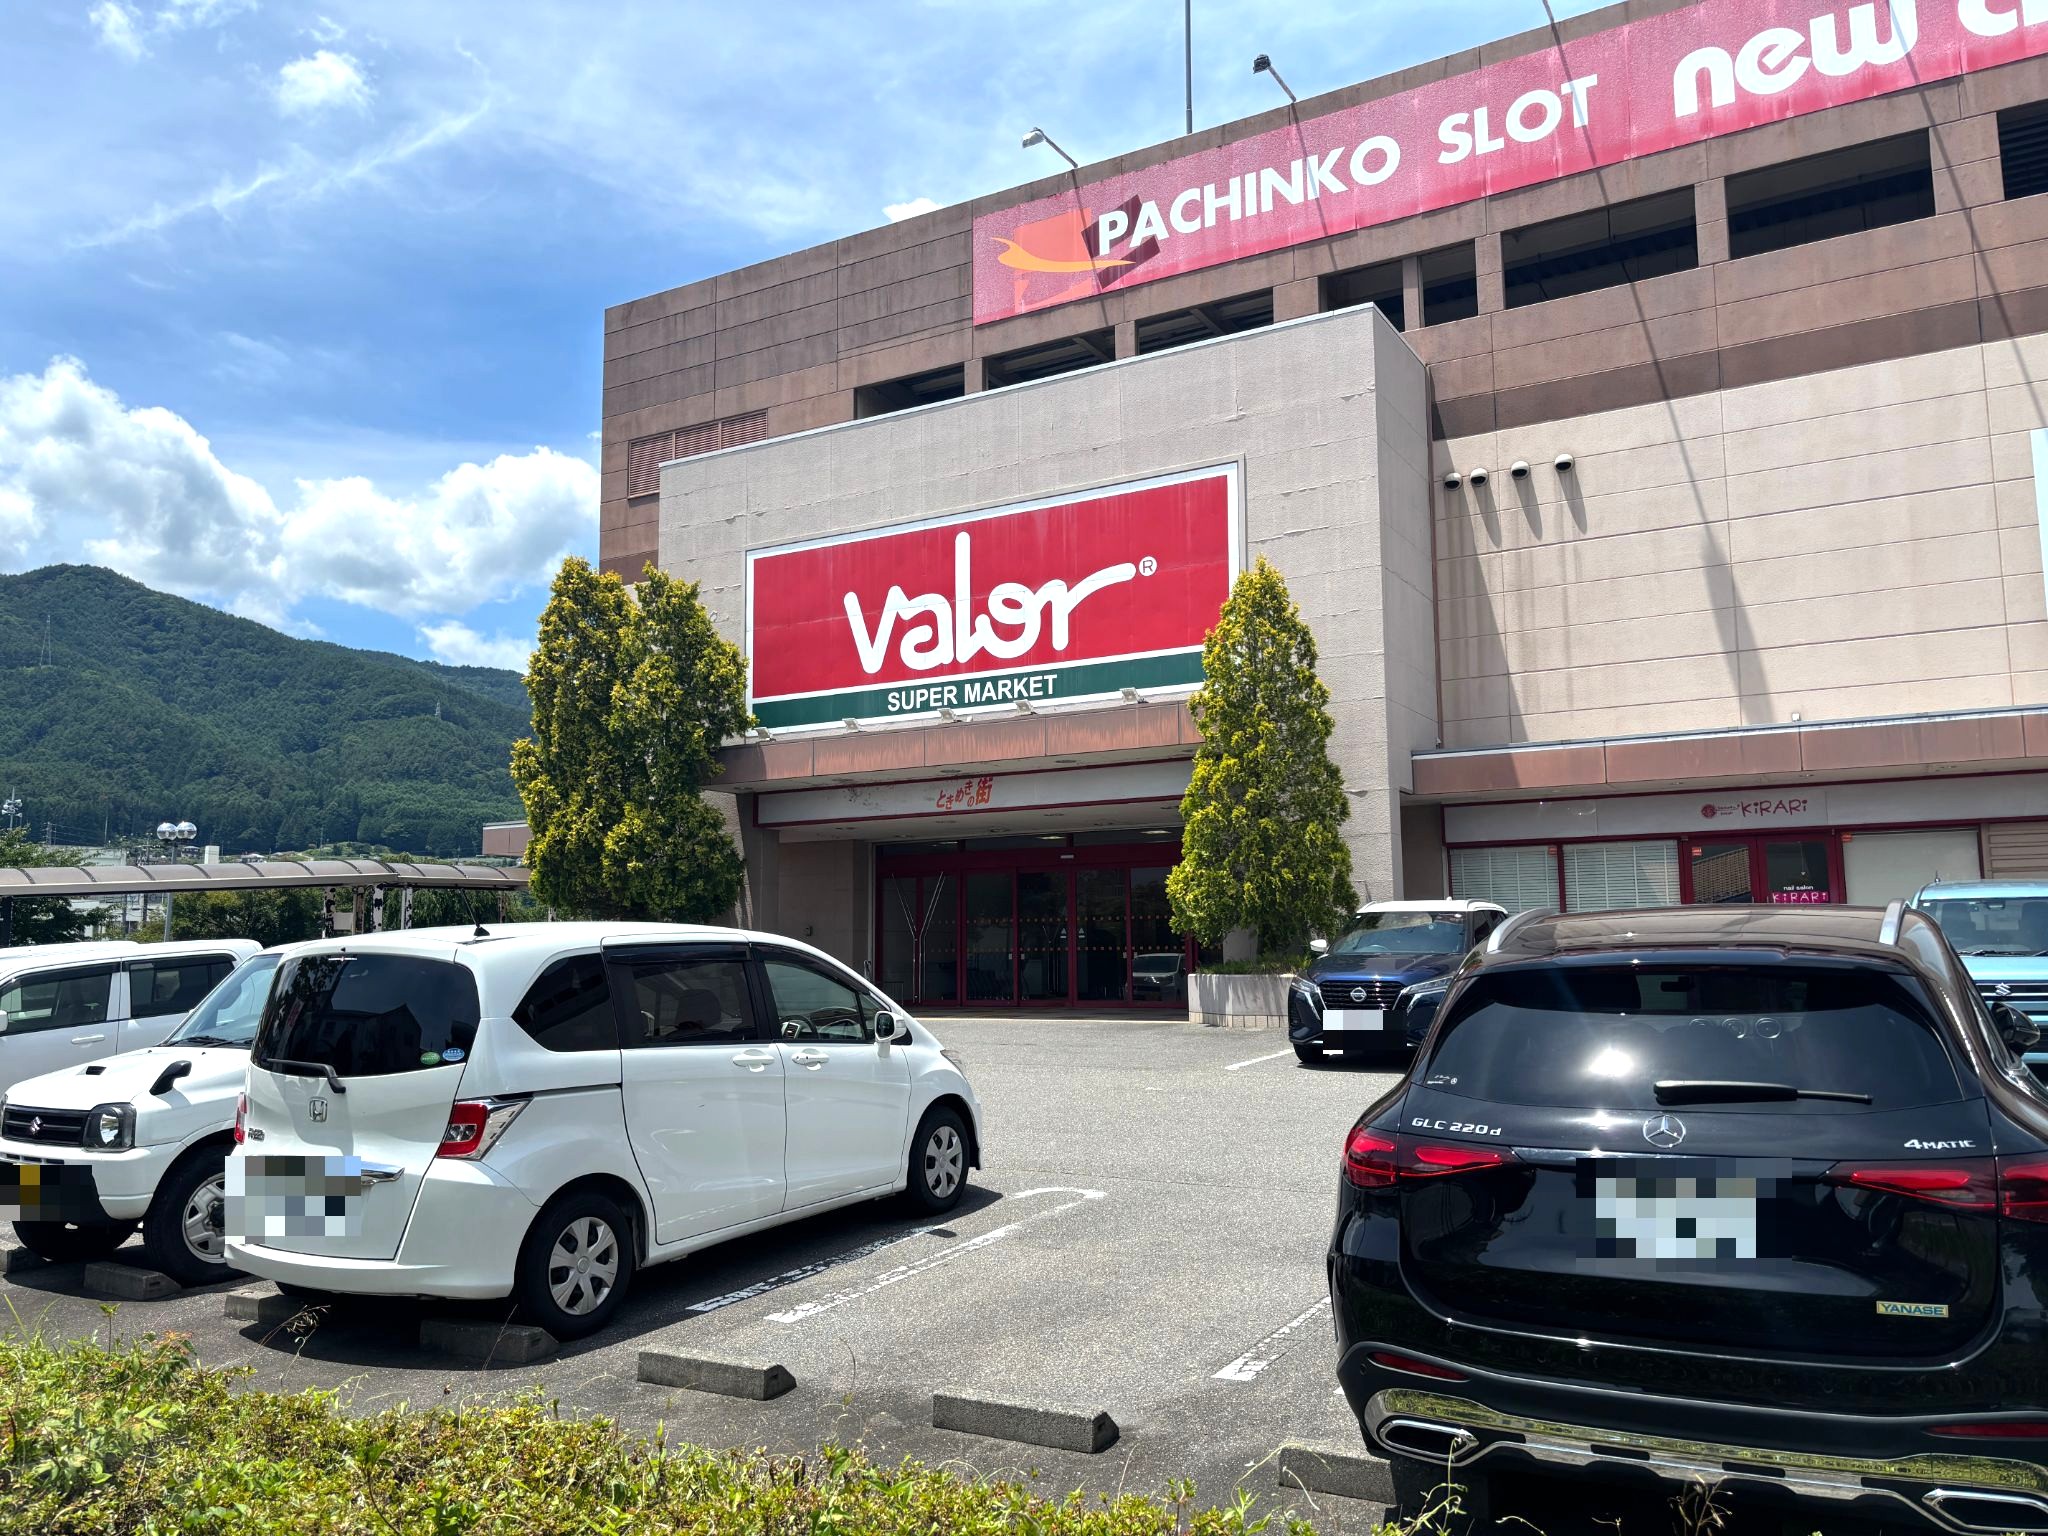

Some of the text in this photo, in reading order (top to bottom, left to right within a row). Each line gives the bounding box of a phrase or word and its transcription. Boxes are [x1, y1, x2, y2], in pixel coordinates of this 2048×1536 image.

[1098, 135, 1400, 255] PACHINKO
[1438, 74, 1598, 164] SLOT
[887, 674, 1058, 712] SUPER MARKET
[936, 776, 994, 810] ときめきの街
[1411, 1117, 1448, 1130] GLC
[1904, 1139, 1976, 1150] 4MATIC
[1881, 1303, 1945, 1316] YANASE
